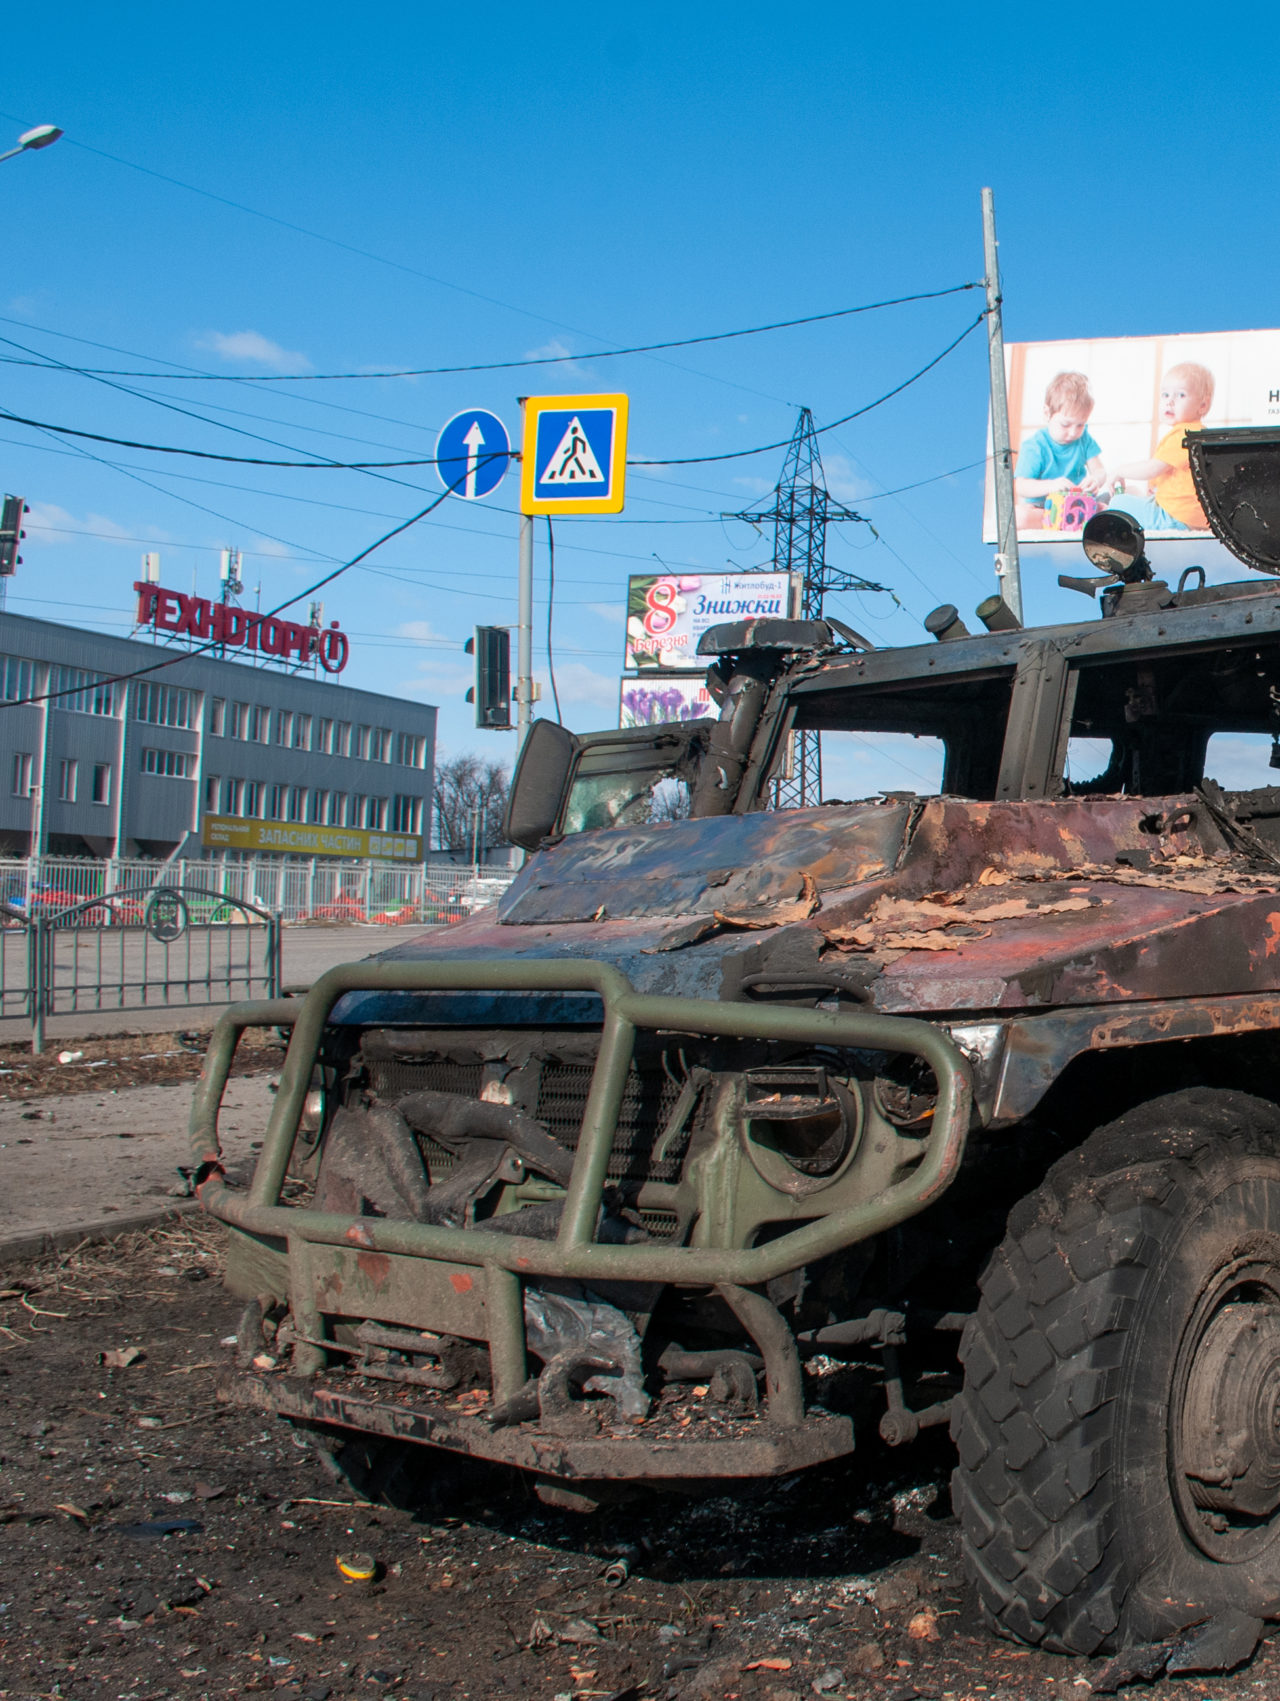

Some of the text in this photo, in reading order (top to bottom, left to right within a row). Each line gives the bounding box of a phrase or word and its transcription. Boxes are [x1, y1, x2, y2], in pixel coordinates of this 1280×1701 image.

[644, 584, 676, 634] 8
[693, 594, 781, 615] Знижки
[133, 581, 319, 662] ТЕХНОТОРГ
[634, 635, 688, 654] Березня
[258, 828, 362, 851] ЗАПАСНИХ ЧАСТИН
